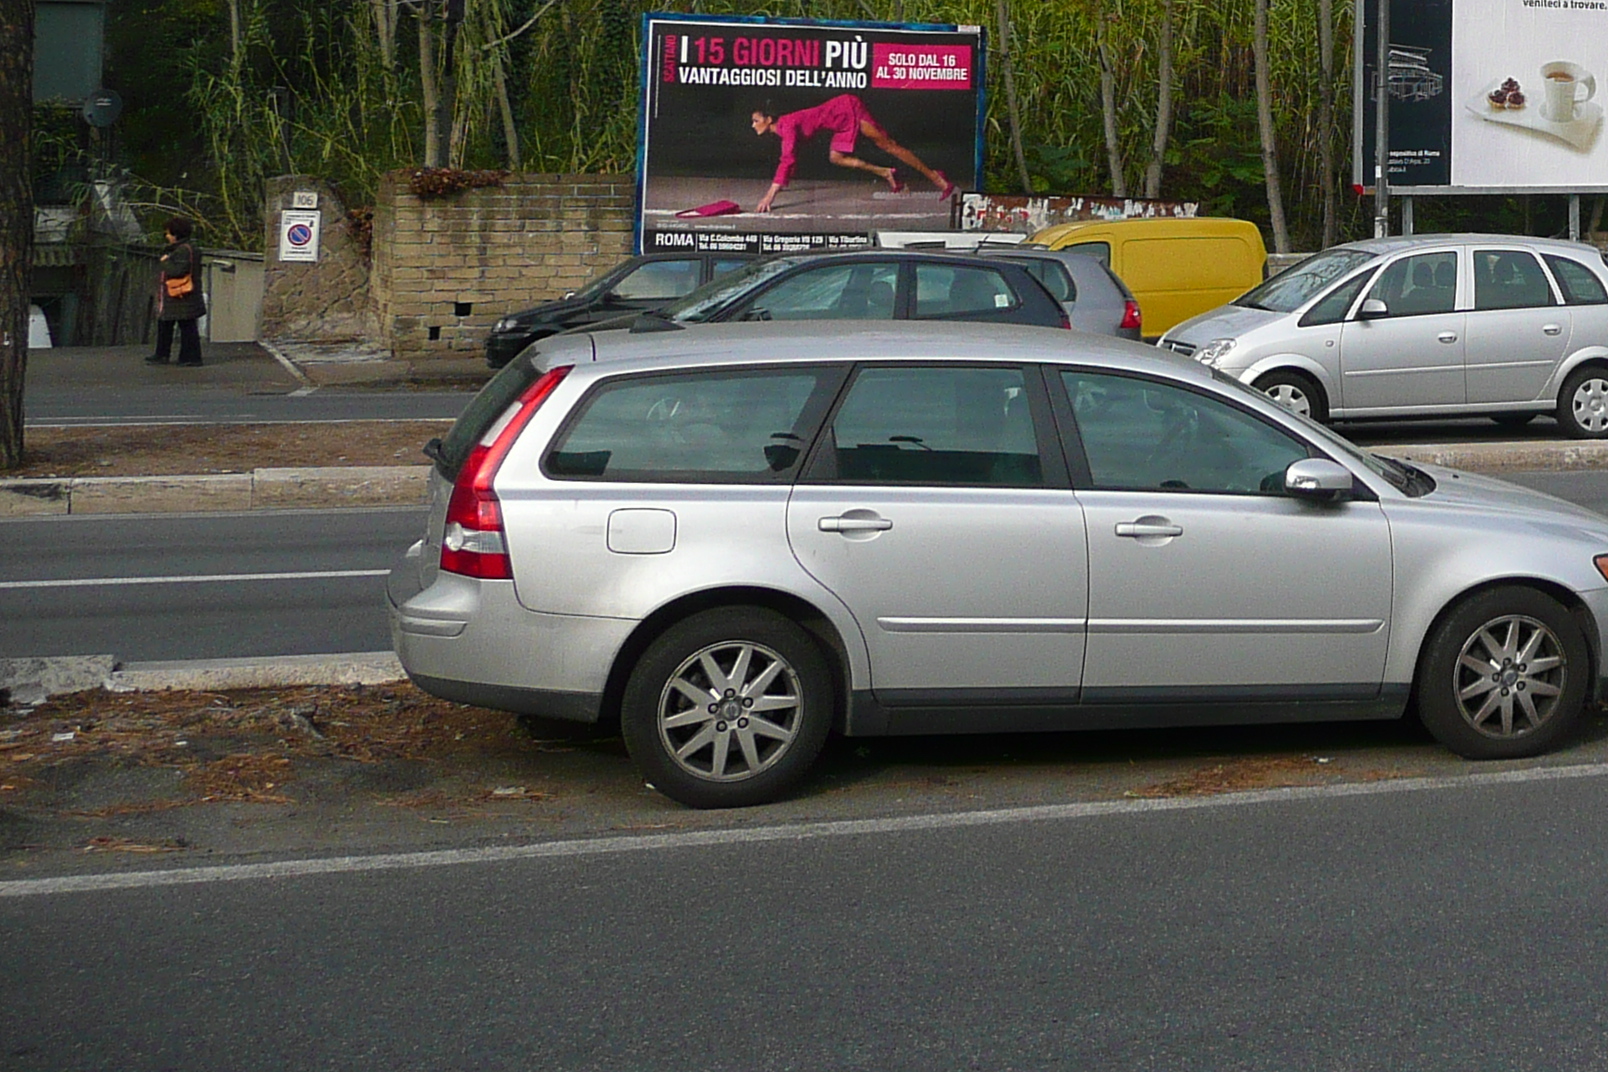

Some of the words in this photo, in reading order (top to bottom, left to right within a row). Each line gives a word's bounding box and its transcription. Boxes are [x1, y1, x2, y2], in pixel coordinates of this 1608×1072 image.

[1562, 0, 1569, 8] a
[1570, 0, 1608, 10] trovare.
[663, 34, 677, 83] SCATTANO
[680, 35, 689, 63] I
[694, 37, 724, 64] 15
[733, 37, 820, 67] GIORNI
[825, 35, 868, 69] PIÙ
[888, 53, 916, 66] SOLO
[918, 54, 940, 67] DAL
[942, 55, 956, 67] 16
[679, 67, 781, 86] VANTAGGIOSI
[785, 69, 867, 89] DELL'ANNO
[876, 66, 891, 79] AL
[892, 67, 906, 80] 30
[909, 68, 968, 80] NOVEMBRE
[297, 194, 314, 206] 106
[655, 233, 694, 247] ROMA
